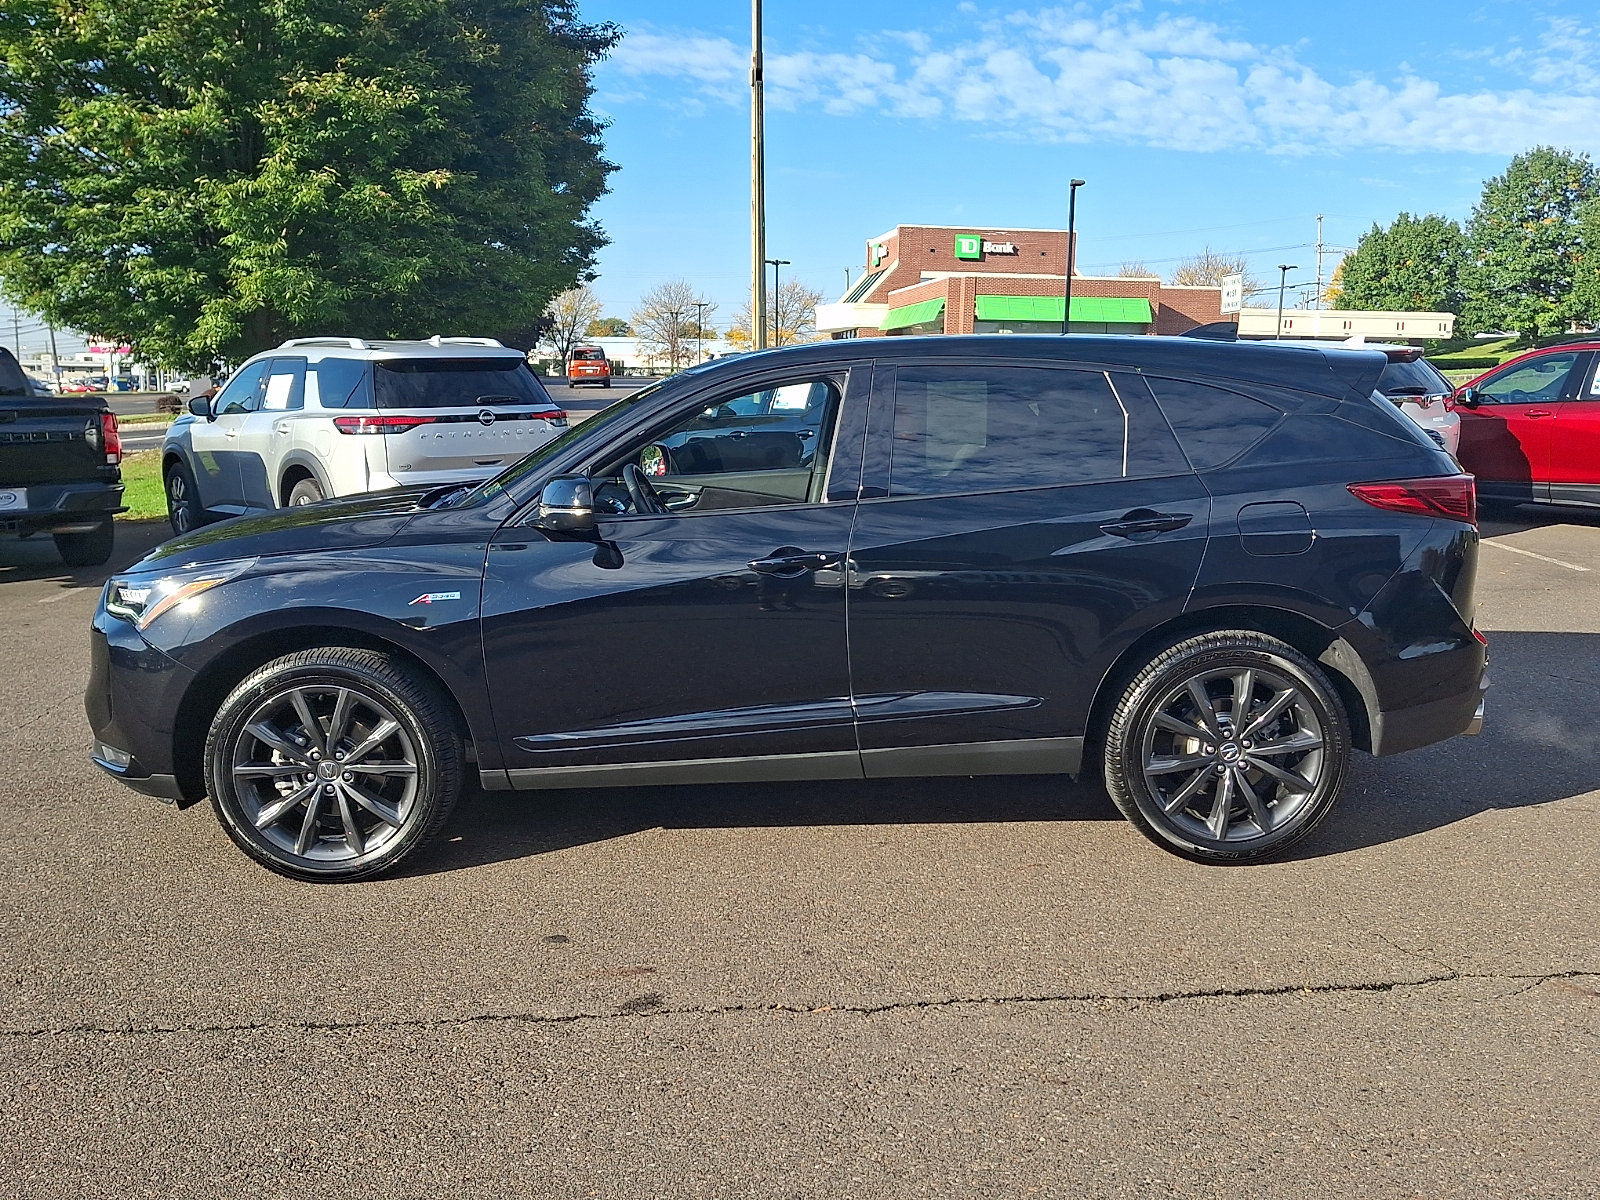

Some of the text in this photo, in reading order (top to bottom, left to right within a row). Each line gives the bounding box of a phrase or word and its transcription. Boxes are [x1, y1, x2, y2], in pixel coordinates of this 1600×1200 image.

[958, 238, 1014, 254] TD Bank
[419, 427, 546, 440] PATHFINDER
